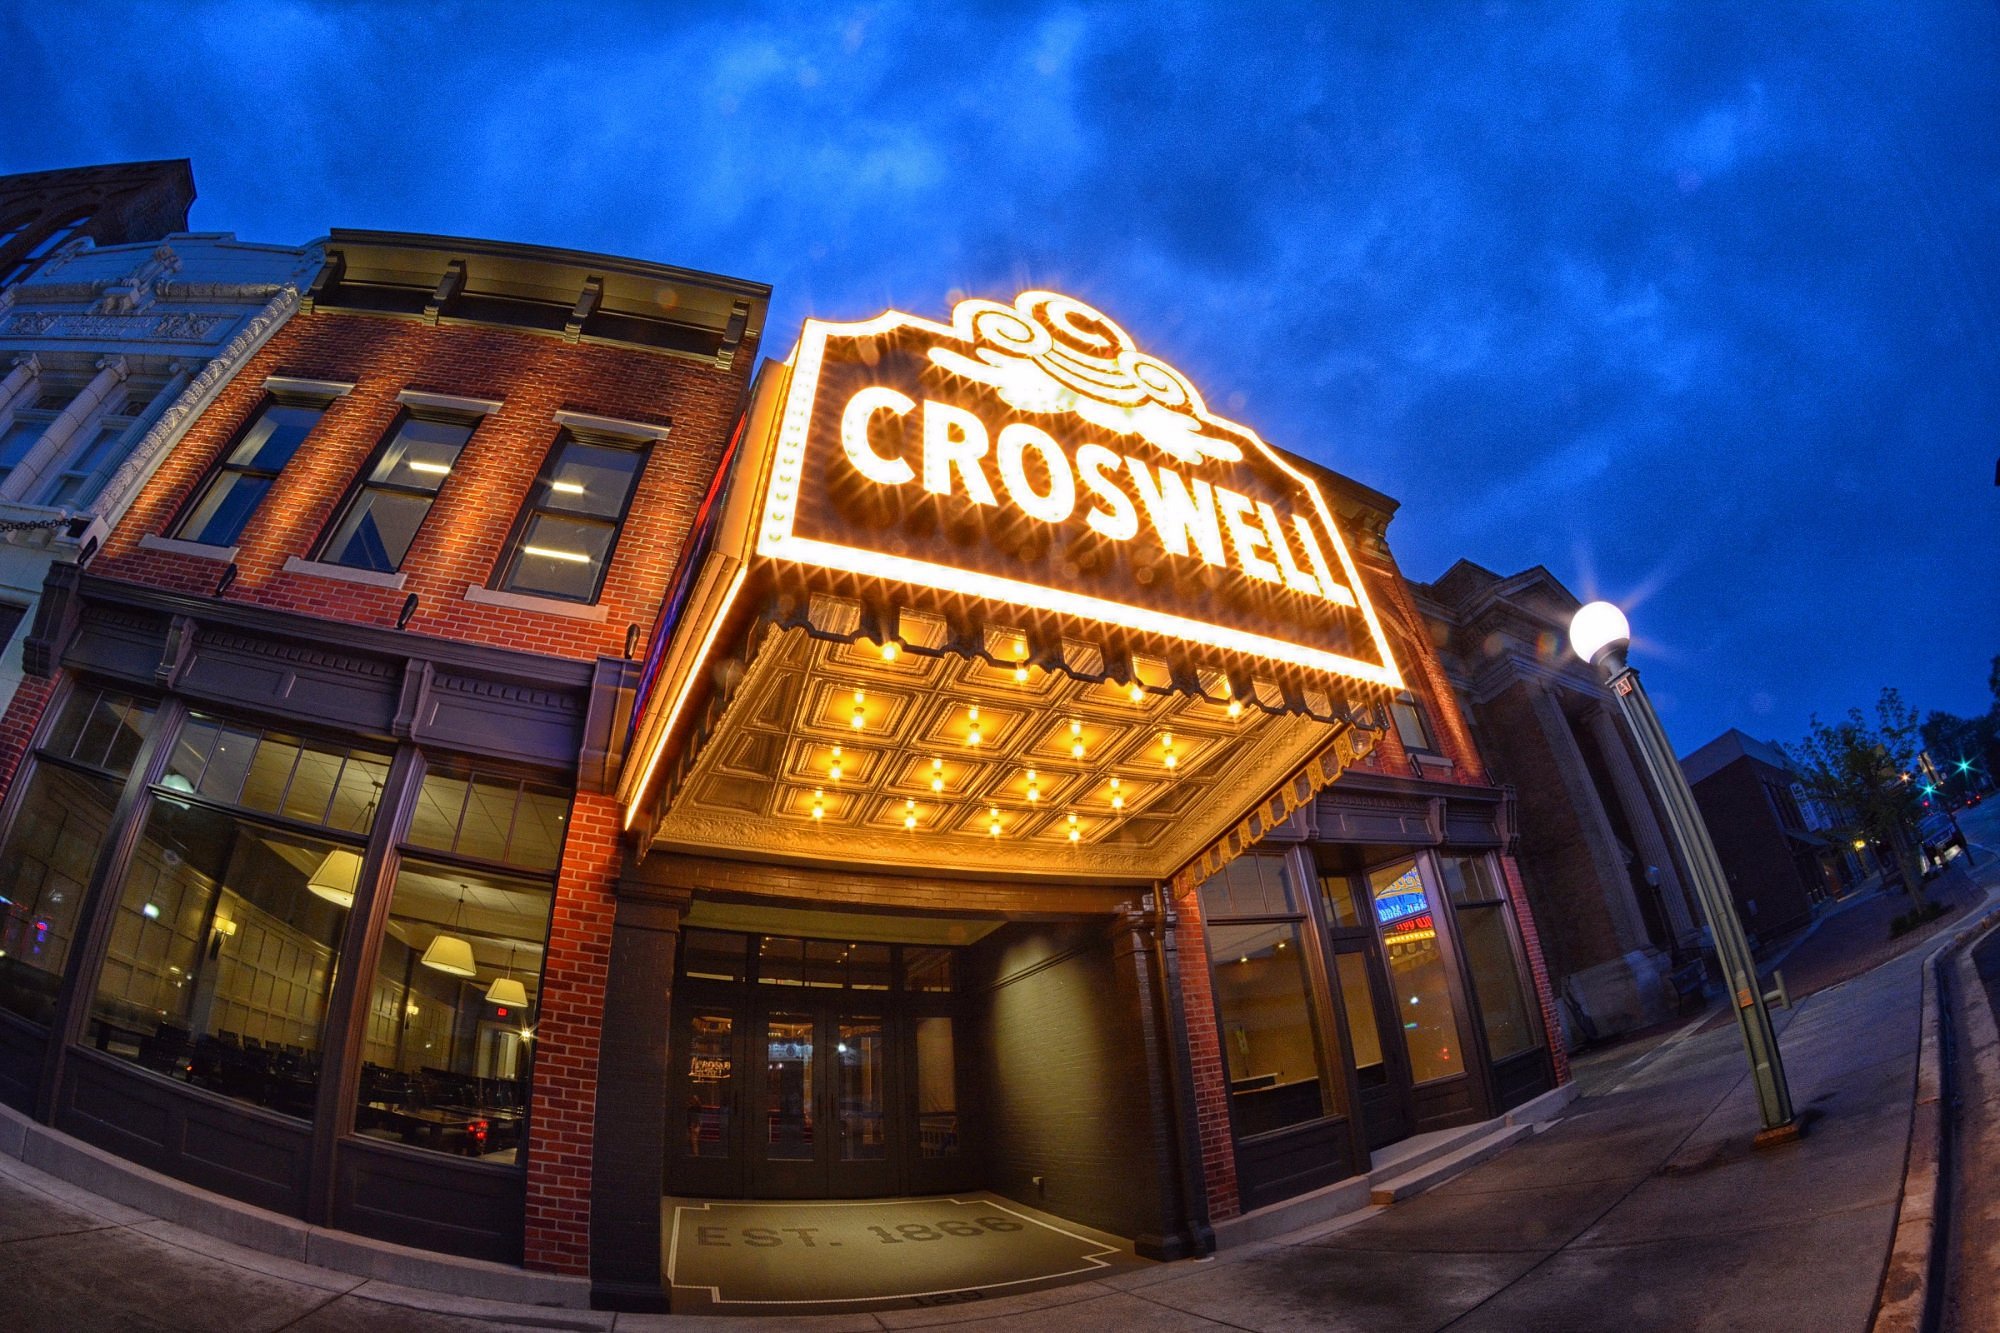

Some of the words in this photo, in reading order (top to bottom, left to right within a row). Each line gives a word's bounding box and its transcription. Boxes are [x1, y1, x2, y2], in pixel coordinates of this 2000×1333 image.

[840, 386, 1357, 609] CROSWELL
[696, 1225, 844, 1248] EST.
[867, 1216, 1025, 1244] 1866
